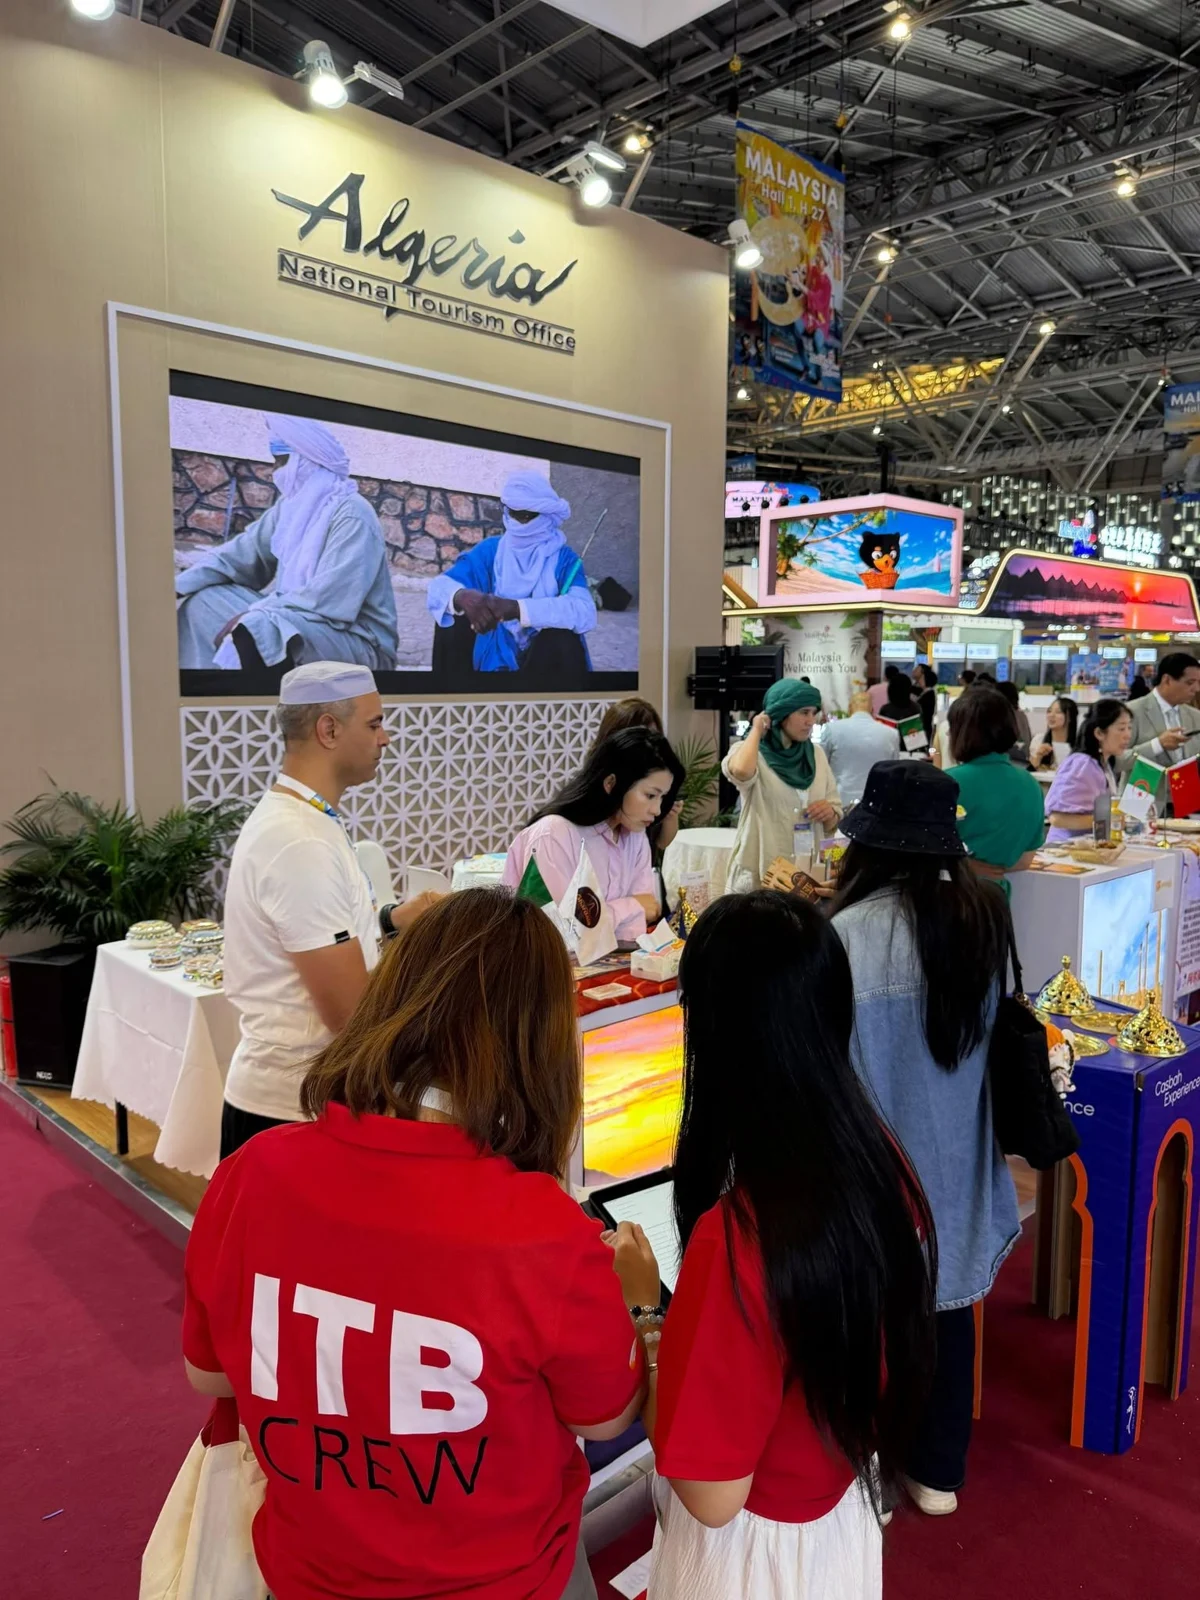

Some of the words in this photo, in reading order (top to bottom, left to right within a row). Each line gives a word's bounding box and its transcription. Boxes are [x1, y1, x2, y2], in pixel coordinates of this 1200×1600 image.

[745, 146, 838, 210] MALAYSIA
[761, 182, 785, 205] Hall
[811, 206, 825, 222] 27
[271, 173, 578, 321] Algeria
[279, 253, 397, 303] National
[406, 287, 504, 331] Tourism
[513, 318, 577, 350] Office
[783, 663, 833, 673] Welcomes
[838, 663, 857, 673] You
[798, 652, 841, 665] Malaysia
[1155, 1069, 1183, 1096] Casbah
[251, 1273, 488, 1435] ITB
[259, 1416, 488, 1504] CREW
